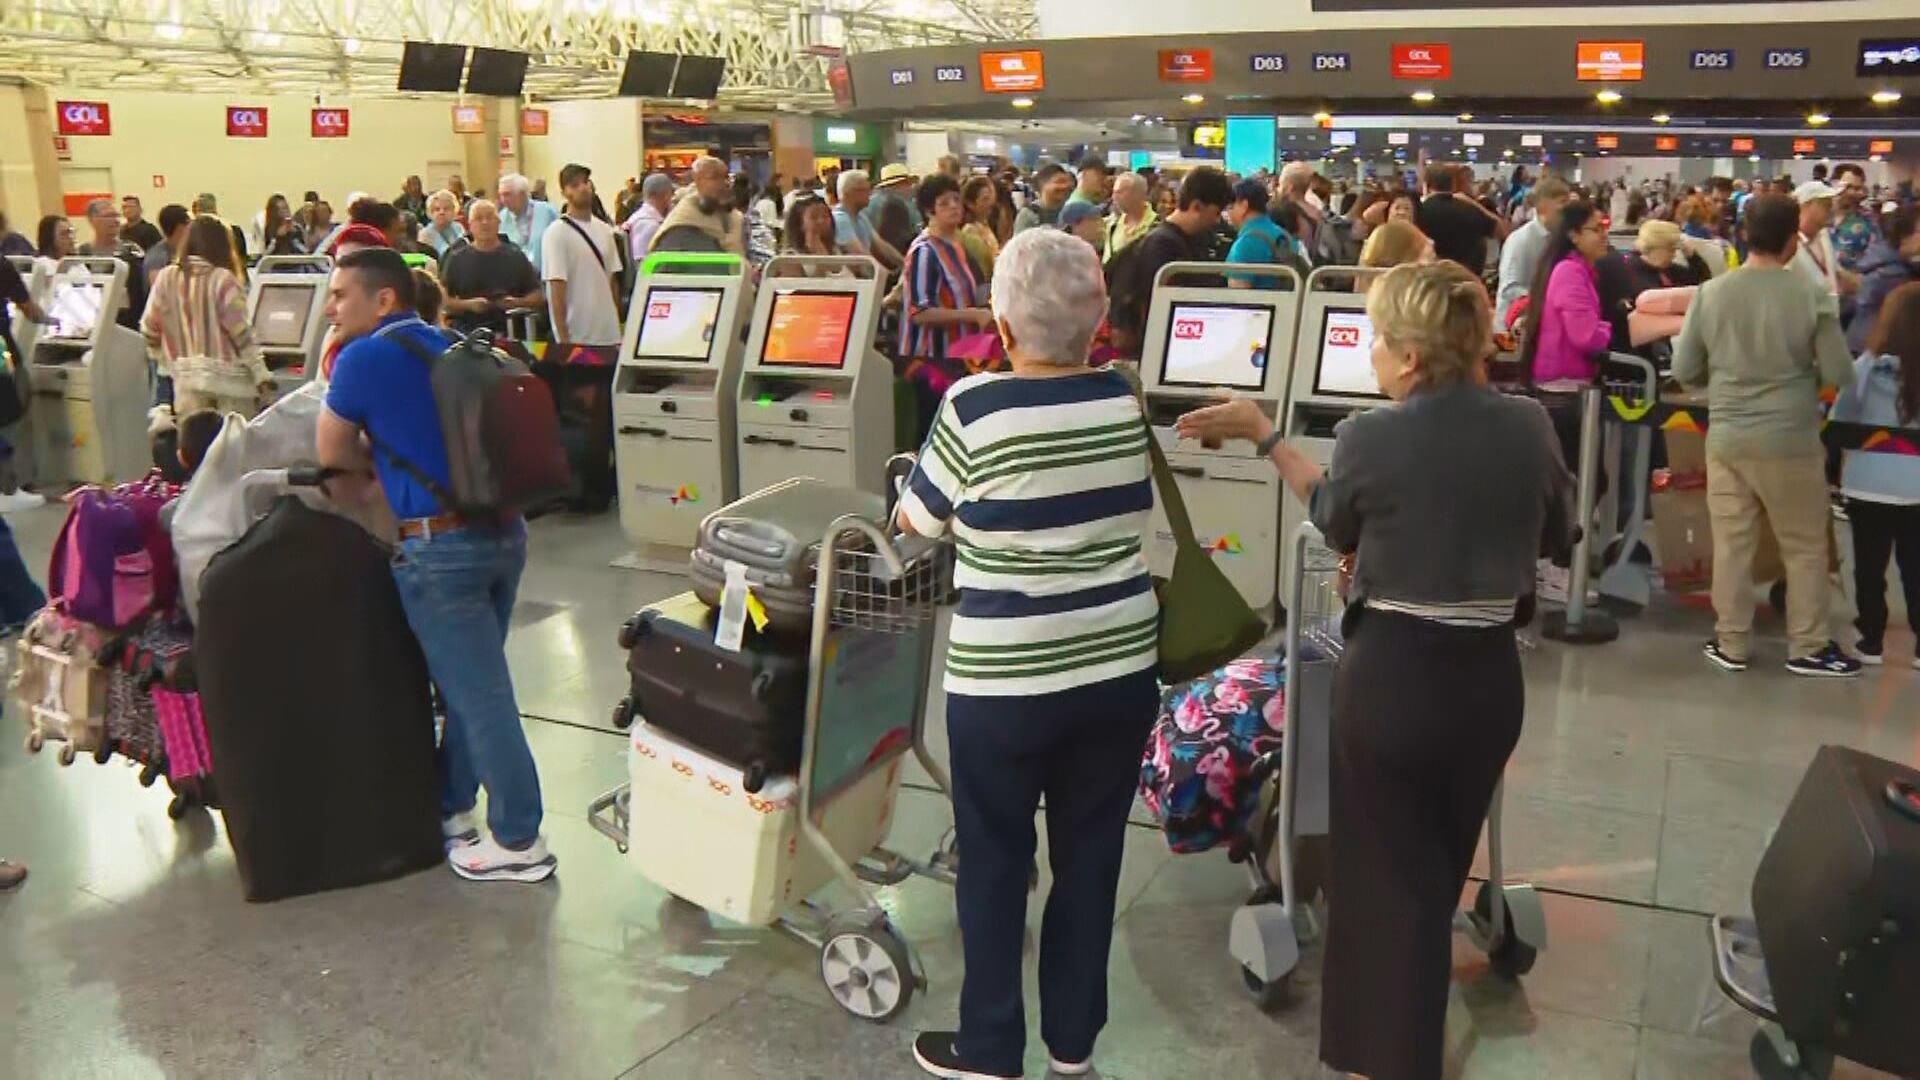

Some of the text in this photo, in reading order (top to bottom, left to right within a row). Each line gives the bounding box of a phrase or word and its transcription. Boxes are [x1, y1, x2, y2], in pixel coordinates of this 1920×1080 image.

[1254, 57, 1283, 70] D03
[1316, 56, 1345, 69] D04
[1695, 53, 1728, 66] D05
[1768, 53, 1803, 66] D06
[892, 71, 913, 84] D01
[937, 69, 963, 81] D02
[65, 106, 103, 124] GOL
[233, 110, 263, 126] GOL
[316, 111, 345, 126] GOL
[1175, 322, 1203, 336] GOL
[1329, 331, 1358, 345] GOL
